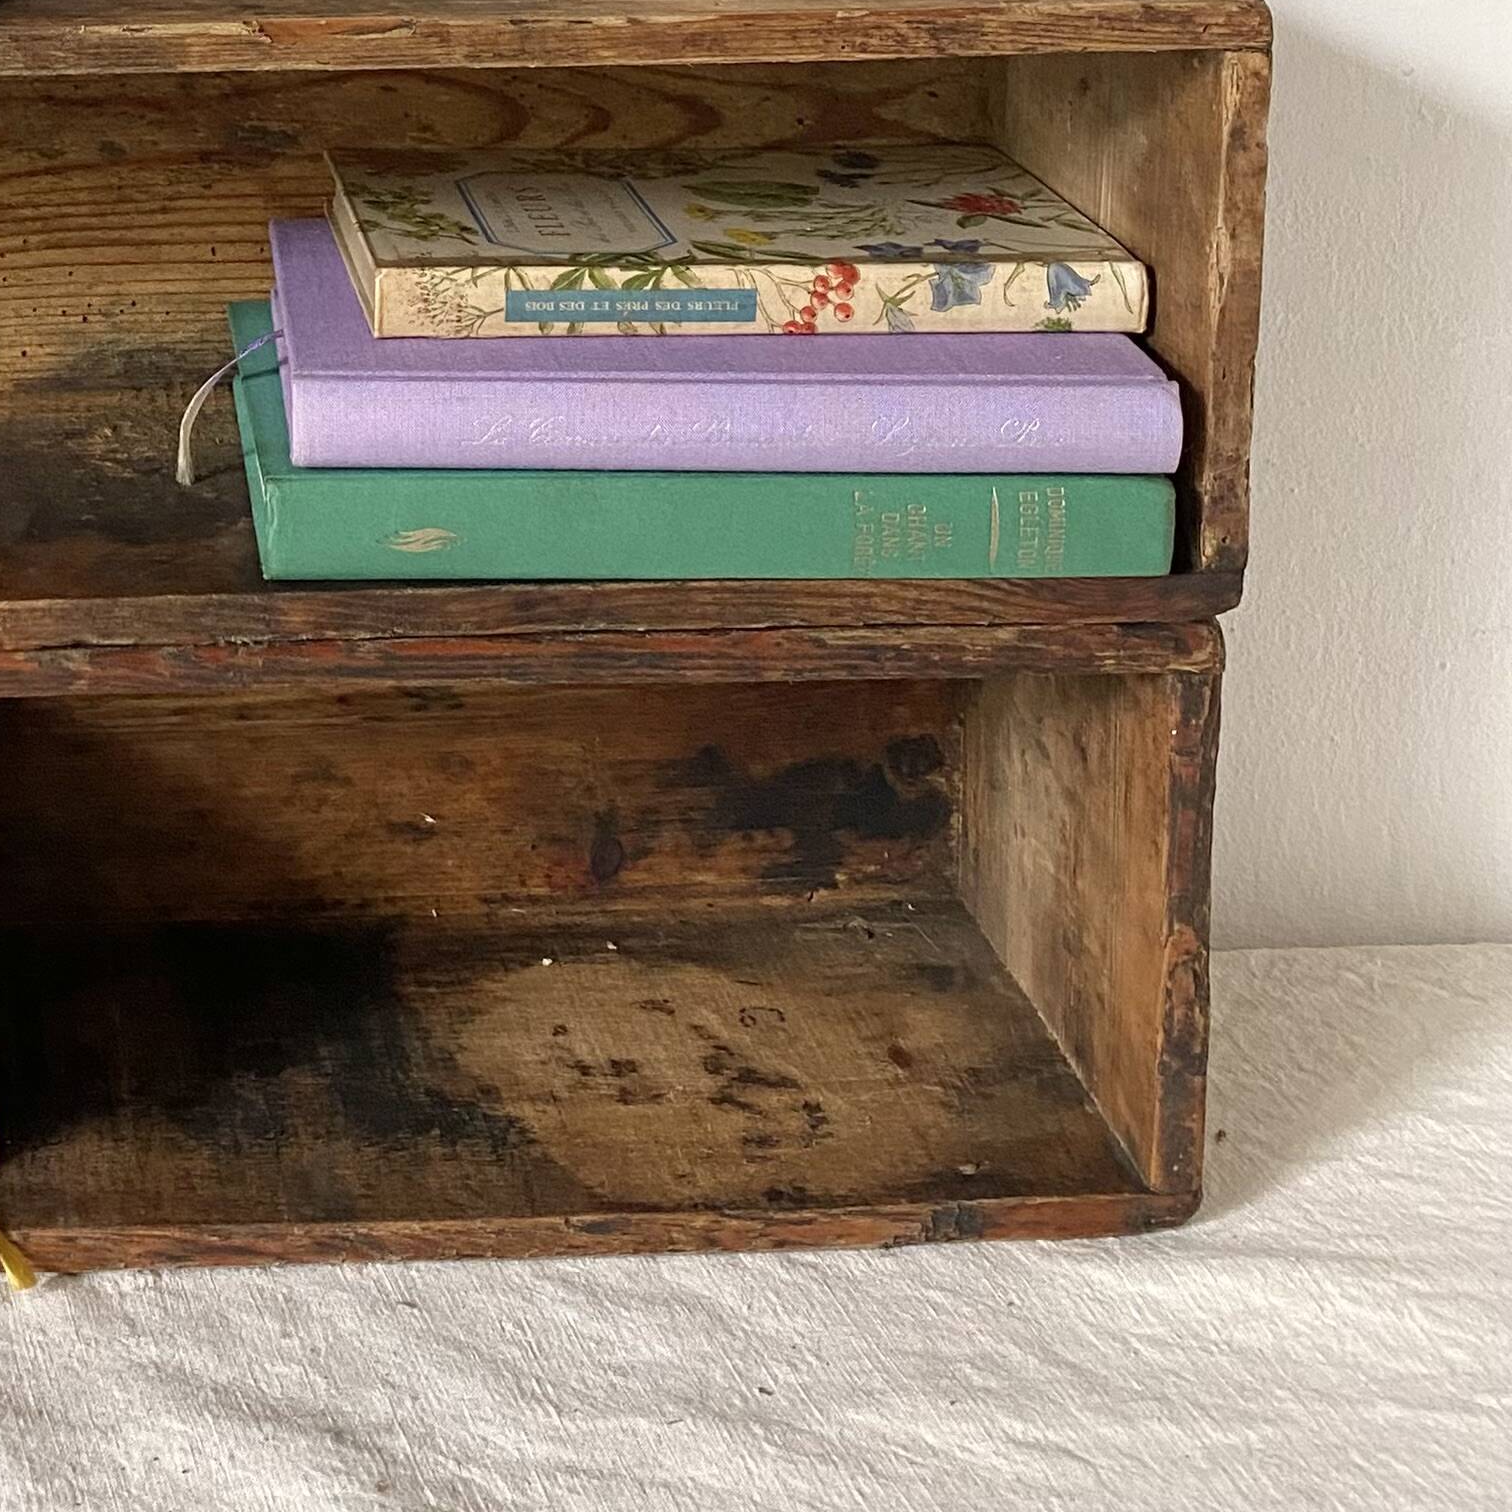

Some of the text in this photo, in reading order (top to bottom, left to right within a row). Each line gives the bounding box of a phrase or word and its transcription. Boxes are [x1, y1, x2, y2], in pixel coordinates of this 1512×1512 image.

[525, 300, 739, 318] FLEURS DES PRÉS ET DES BOIS
